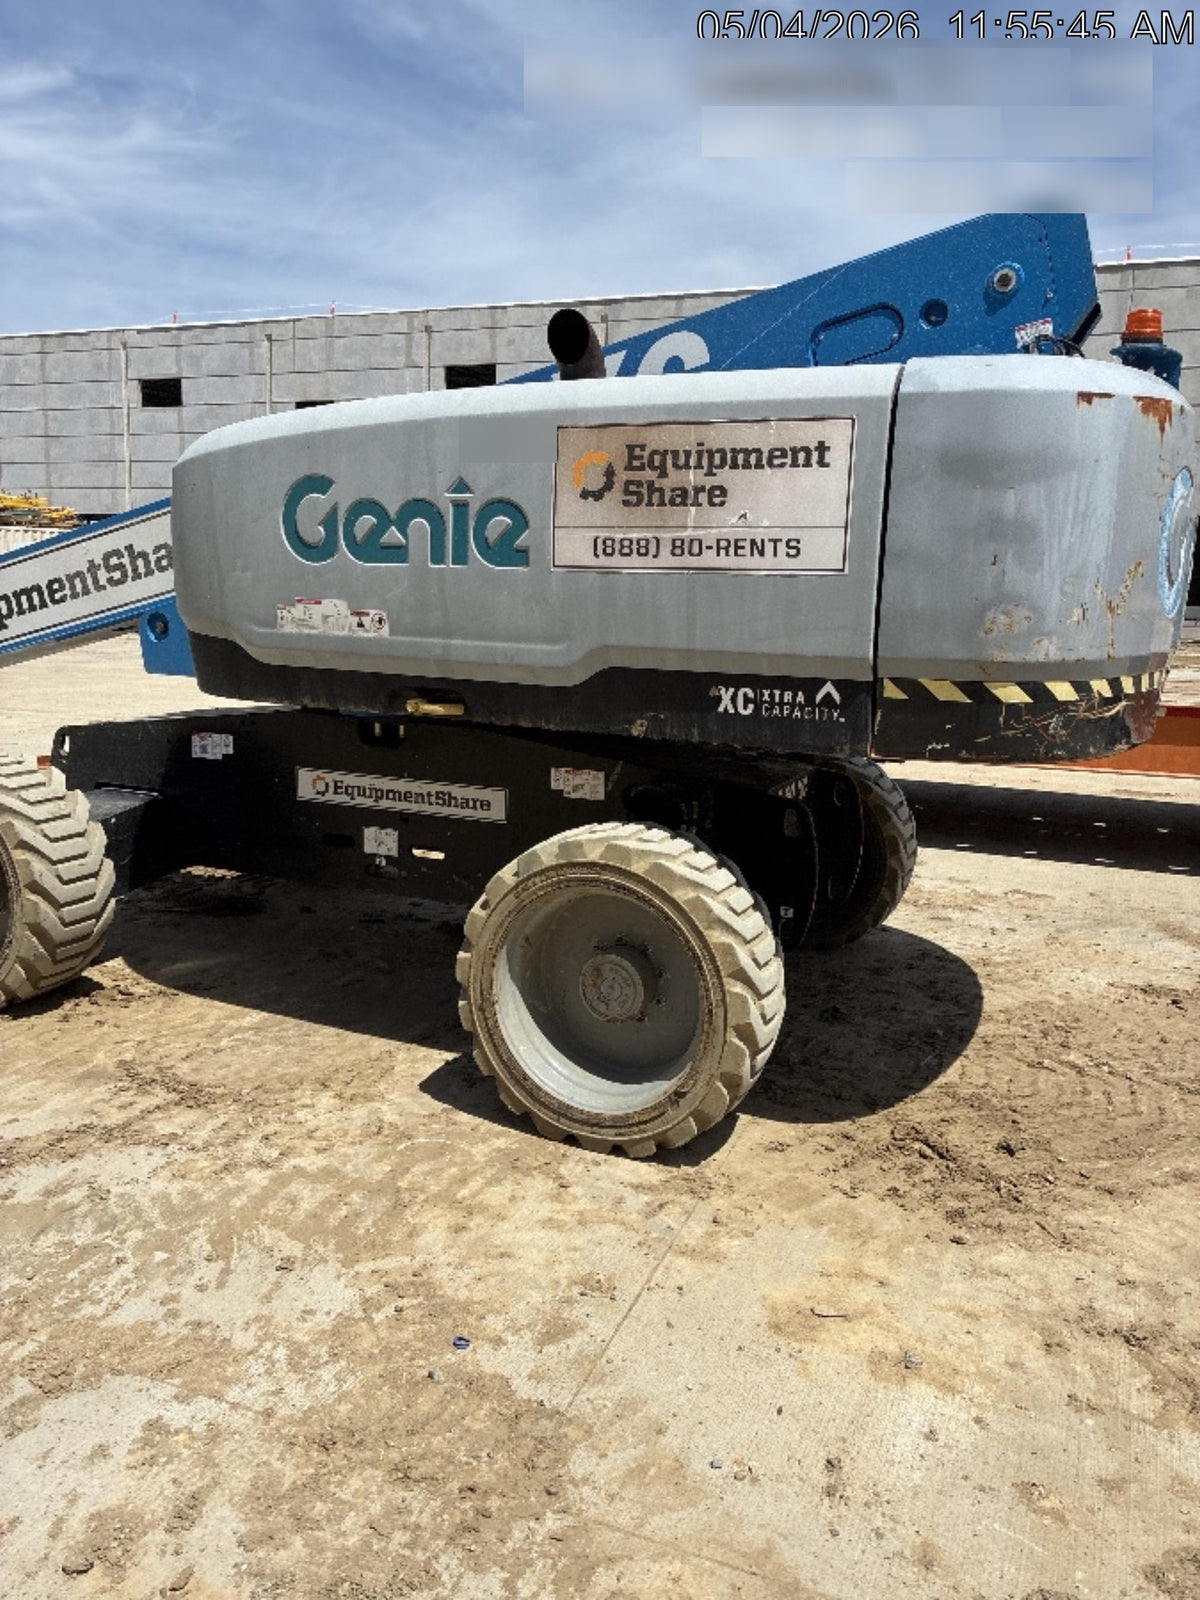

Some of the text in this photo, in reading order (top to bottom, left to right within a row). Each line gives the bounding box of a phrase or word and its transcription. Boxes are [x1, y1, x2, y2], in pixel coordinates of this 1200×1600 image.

[624, 440, 831, 478] Equipment
[622, 479, 728, 507] Share
[280, 473, 530, 570] Genie
[593, 536, 801, 559] (888) 80-RENTS
[717, 685, 805, 716] XC XTRA
[761, 703, 840, 721] CAPACITY
[333, 779, 492, 812] EquipmentShare
